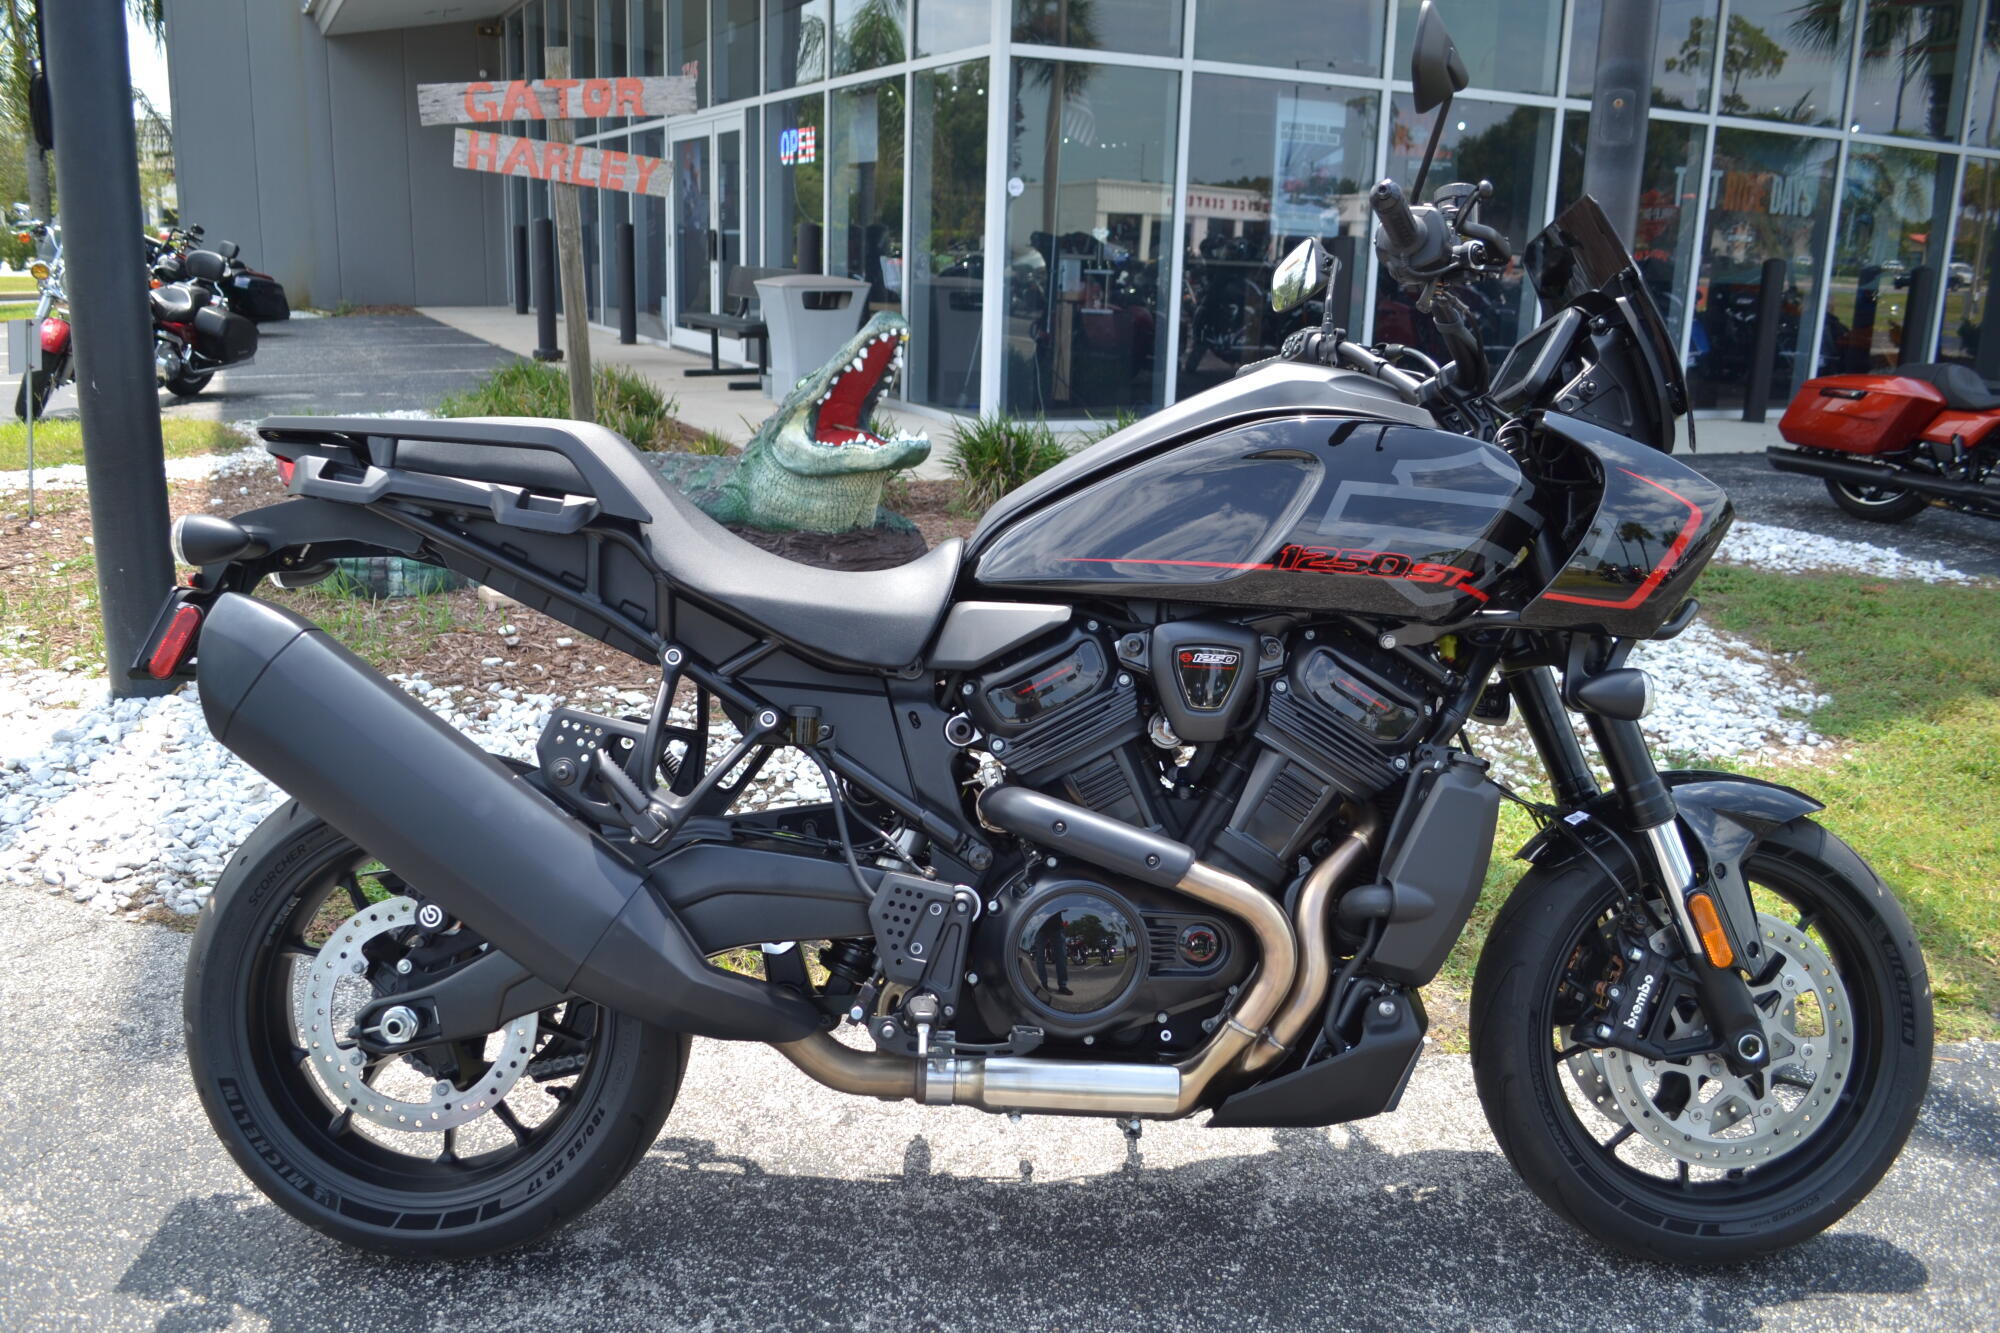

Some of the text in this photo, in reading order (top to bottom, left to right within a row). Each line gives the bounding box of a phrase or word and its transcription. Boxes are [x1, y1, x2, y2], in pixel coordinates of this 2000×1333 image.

[464, 78, 646, 122] GATOR
[466, 130, 662, 195] HARLEY
[781, 128, 816, 165] OPEN
[1674, 166, 1724, 210] TT
[1769, 174, 1815, 218] DAYS
[1192, 653, 1237, 665] 1250
[248, 843, 307, 907] SCORCHER
[1623, 974, 1655, 1030] brembo
[1883, 942, 1915, 1042] MICHELIN
[220, 1084, 310, 1190] MICHELIN
[527, 1107, 606, 1195] 180/55 ZR 17
